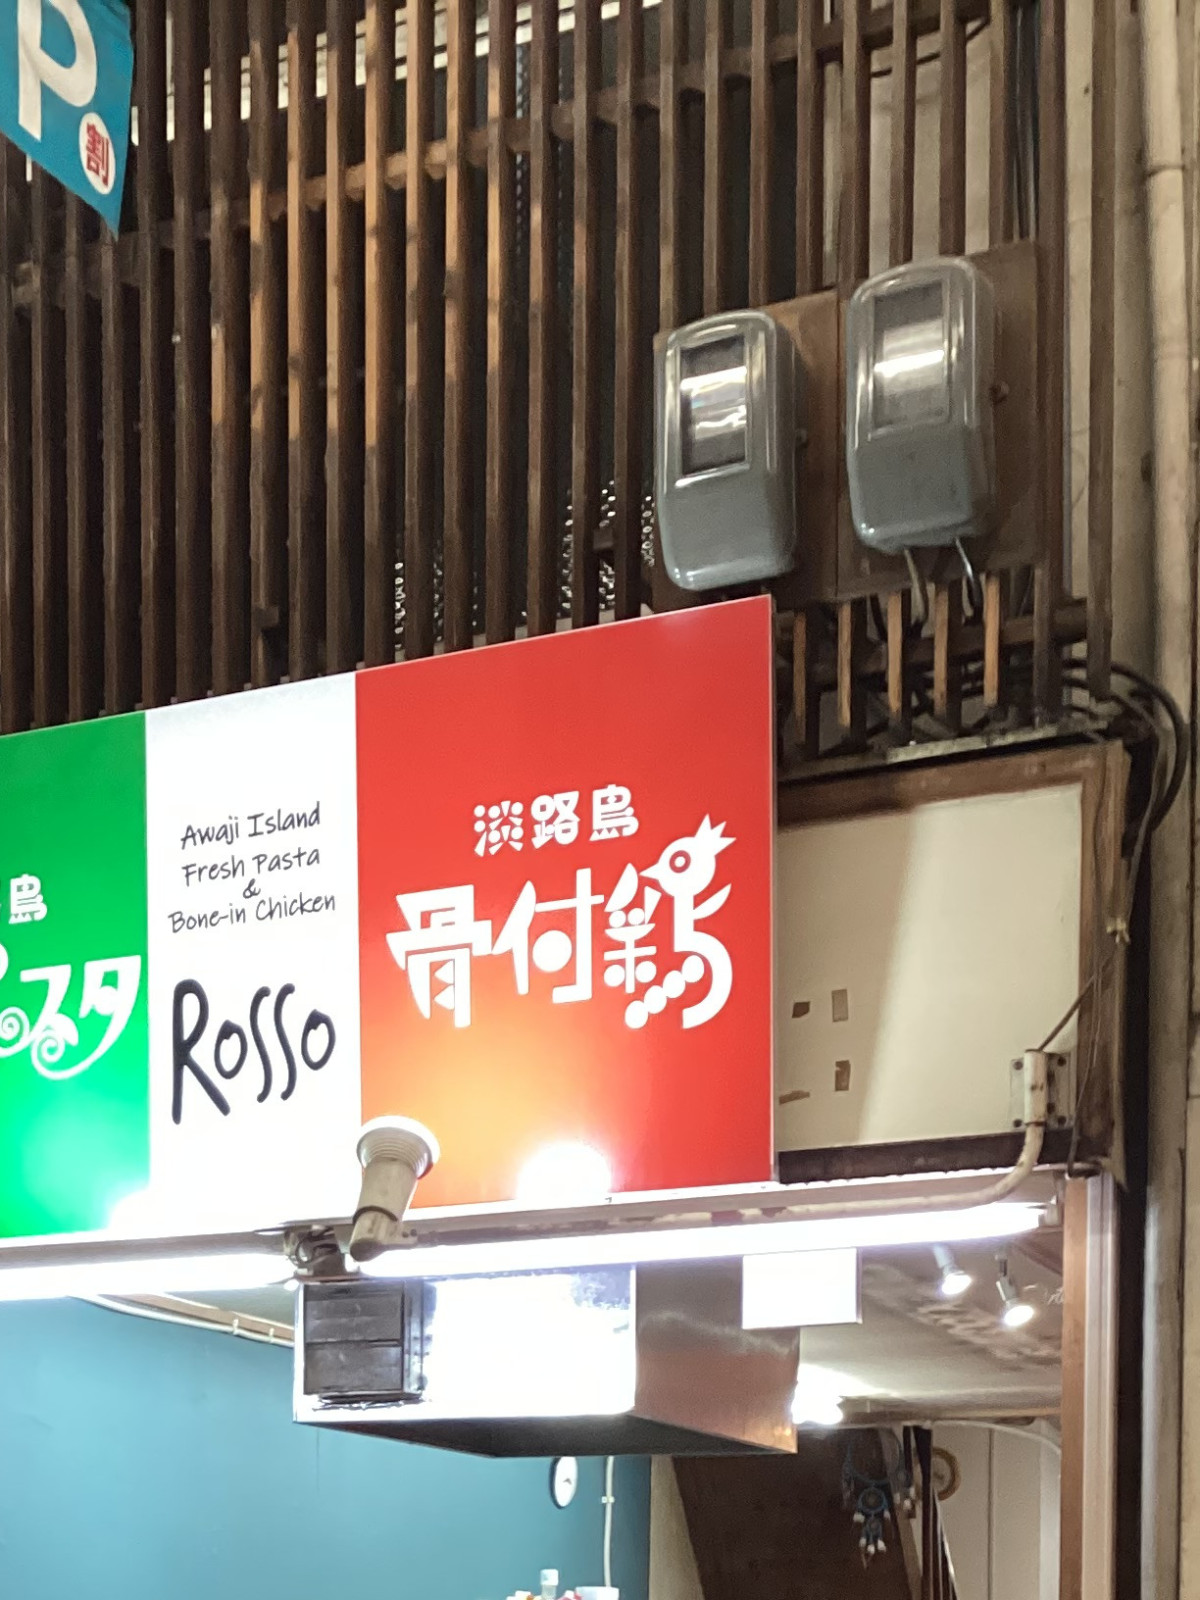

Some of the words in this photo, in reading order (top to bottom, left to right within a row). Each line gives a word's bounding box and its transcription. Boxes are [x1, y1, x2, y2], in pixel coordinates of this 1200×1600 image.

[17, 0, 97, 142] P
[86, 122, 109, 187] 割
[181, 815, 239, 850] Awaji
[247, 800, 320, 837] Island
[473, 784, 639, 857] 淡路島
[181, 855, 245, 887] Fresh
[252, 847, 320, 874] Pasta
[242, 878, 261, 899] &
[168, 903, 246, 933] Bone-in
[256, 892, 335, 920] Chicken
